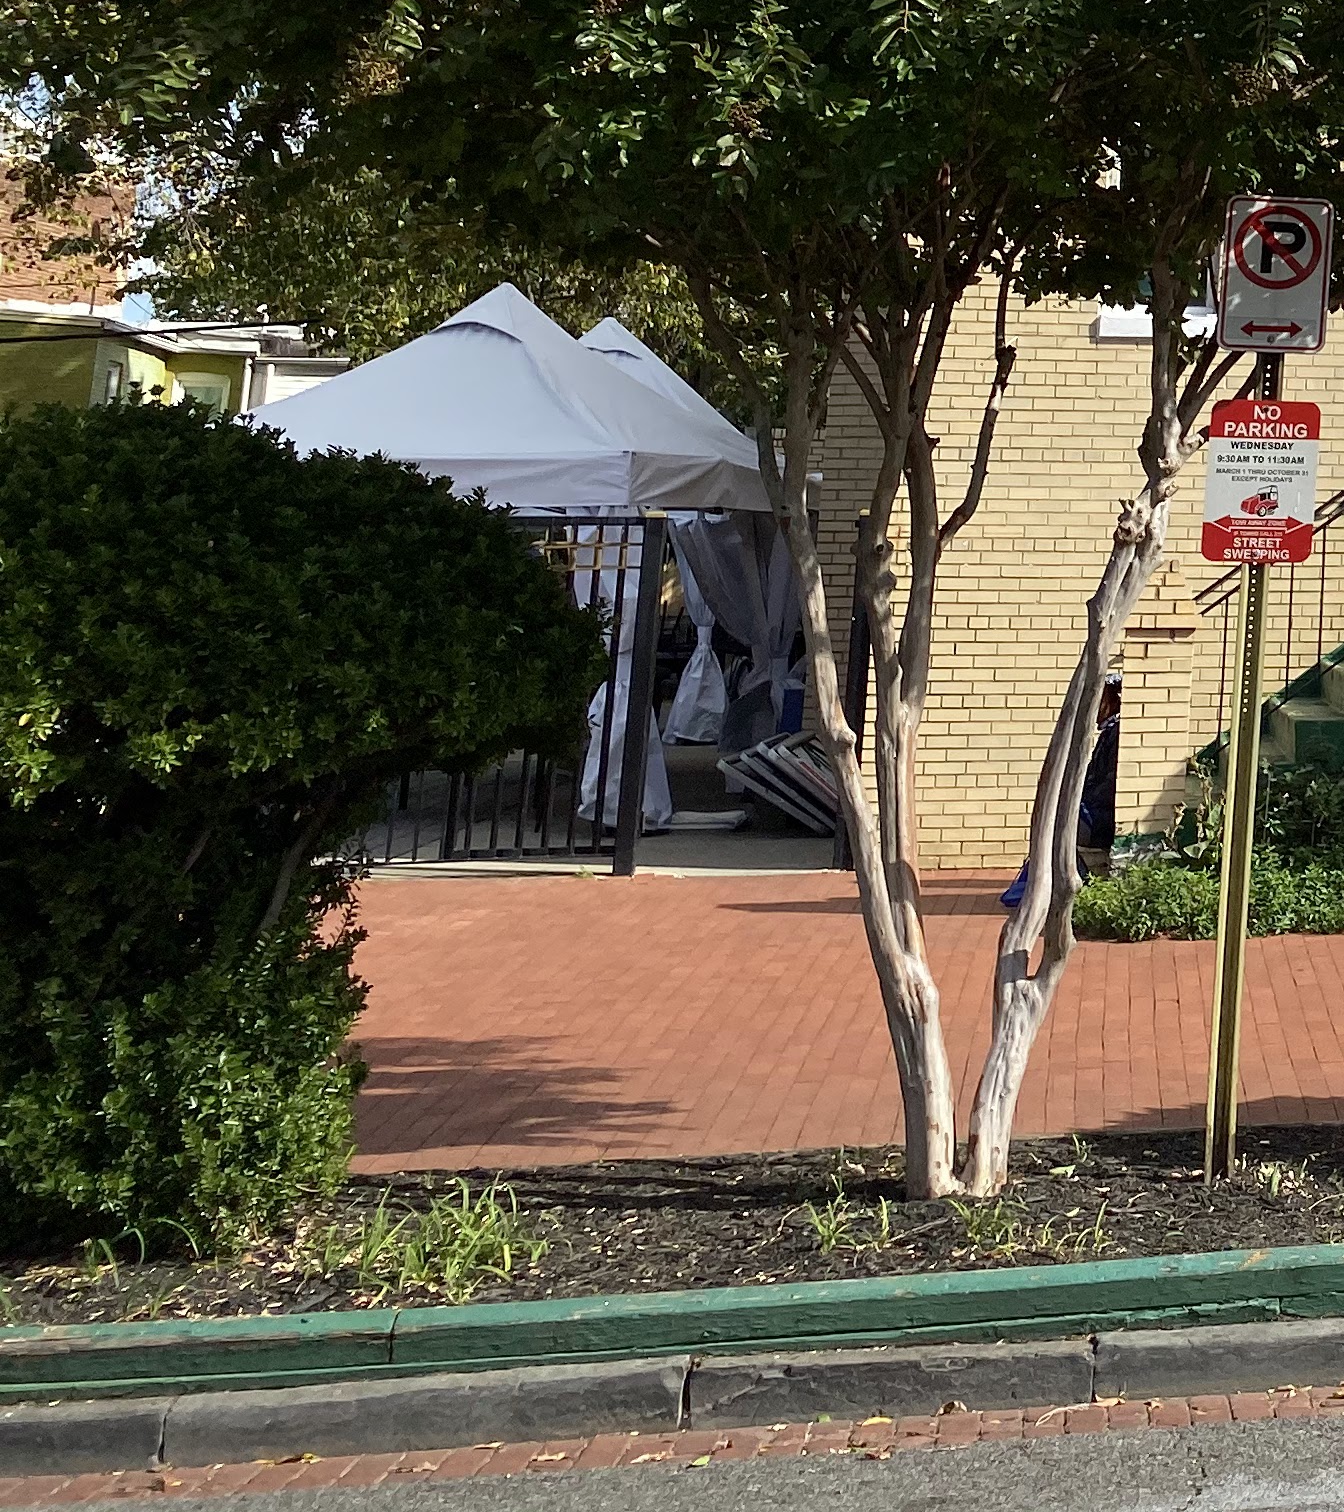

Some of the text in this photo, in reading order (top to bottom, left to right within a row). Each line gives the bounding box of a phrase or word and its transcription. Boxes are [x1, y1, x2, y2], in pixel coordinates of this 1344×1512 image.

[1253, 404, 1281, 421] NO
[1223, 421, 1308, 438] PARKING
[1230, 441, 1294, 450] WEDNESDAY
[1252, 455, 1264, 464] TO
[1233, 537, 1283, 548] STREET
